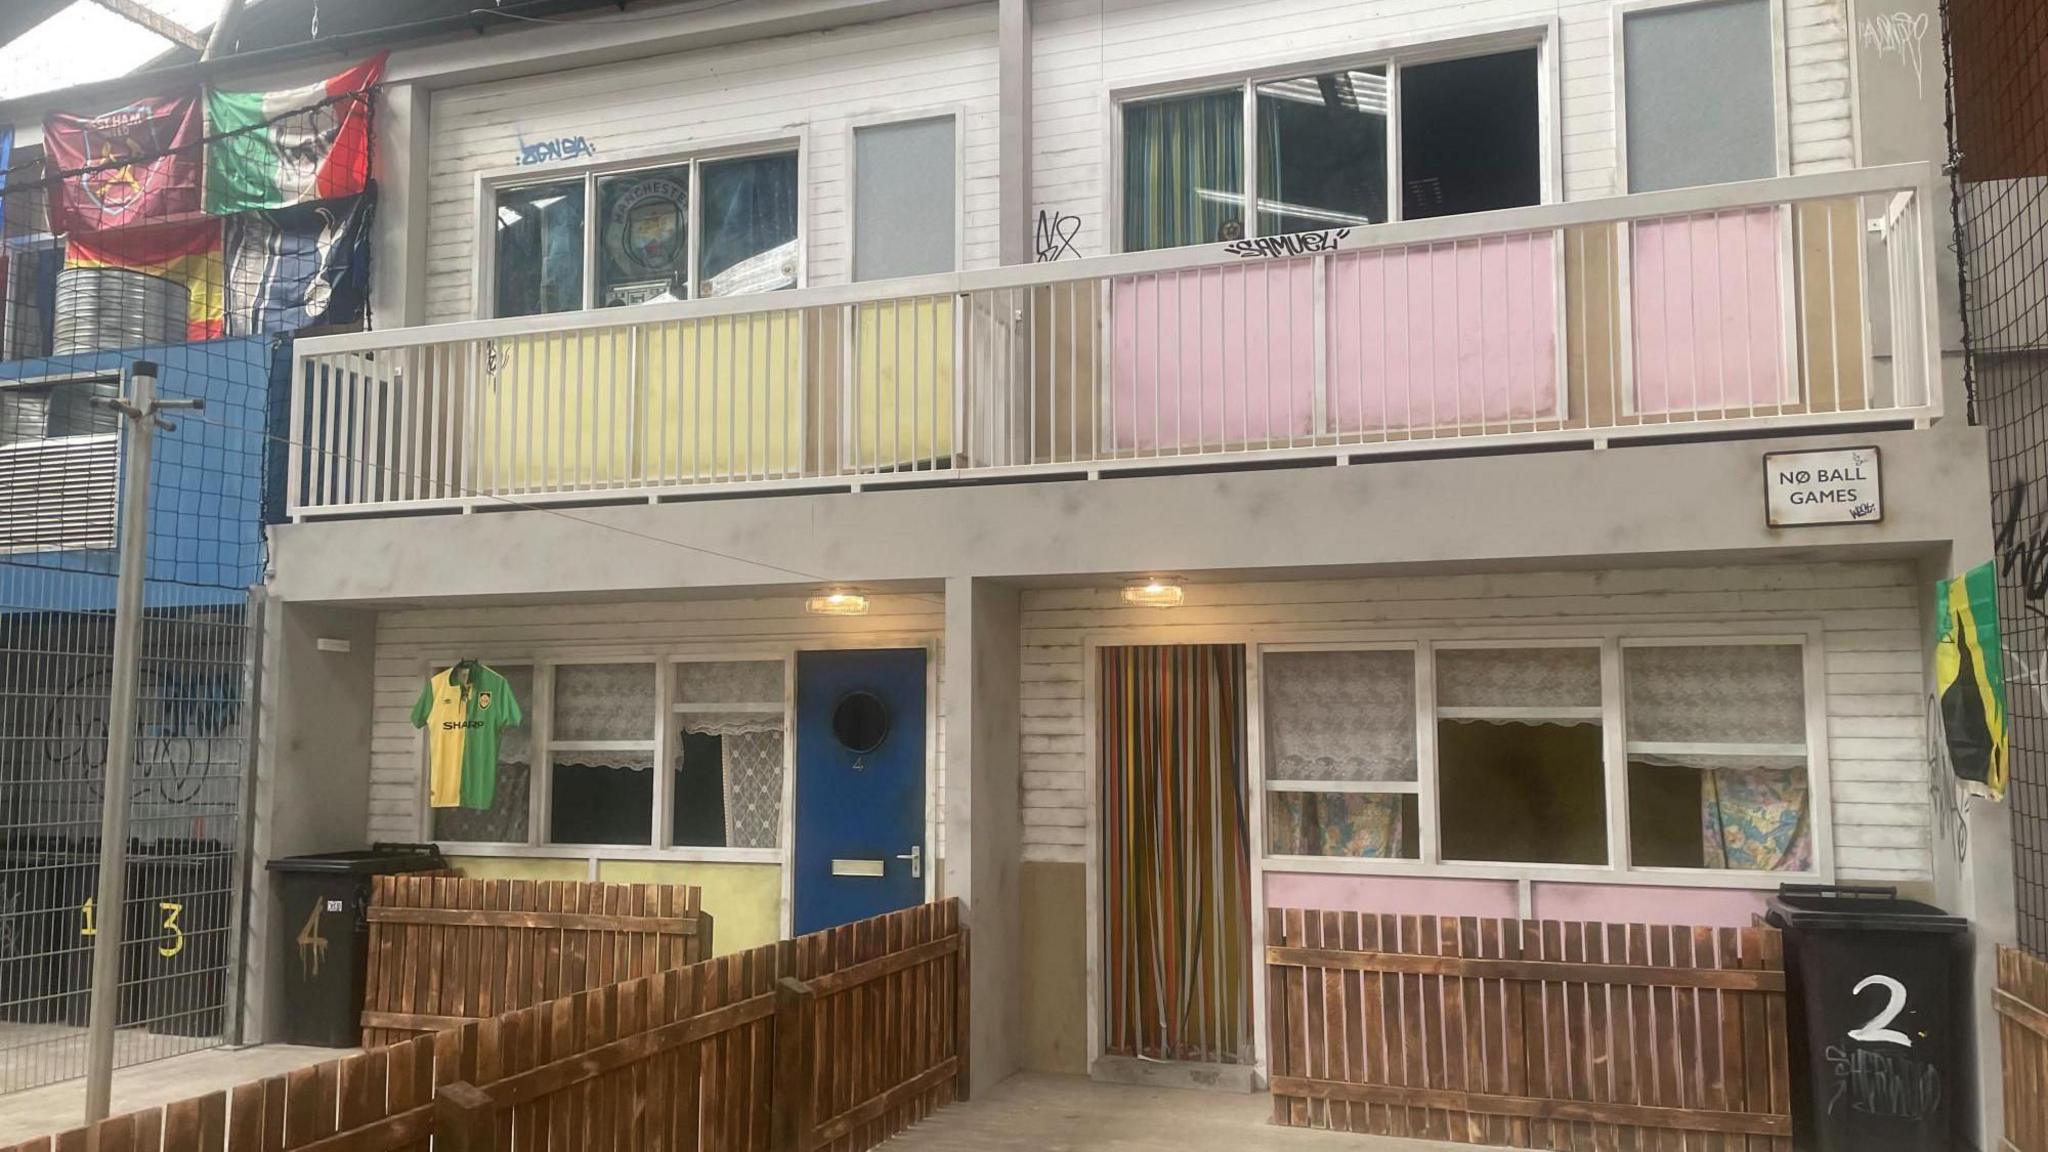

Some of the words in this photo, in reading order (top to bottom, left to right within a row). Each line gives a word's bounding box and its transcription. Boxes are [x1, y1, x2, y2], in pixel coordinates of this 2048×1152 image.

[112, 111, 142, 127] HAM
[1780, 470, 1811, 485] NO
[1818, 467, 1867, 482] BALL
[1790, 488, 1857, 505] GAMES
[443, 720, 484, 731] SHARP
[81, 896, 97, 935] 1
[159, 902, 183, 957] 3
[297, 896, 328, 976] 4
[1848, 974, 1912, 1047] 2
